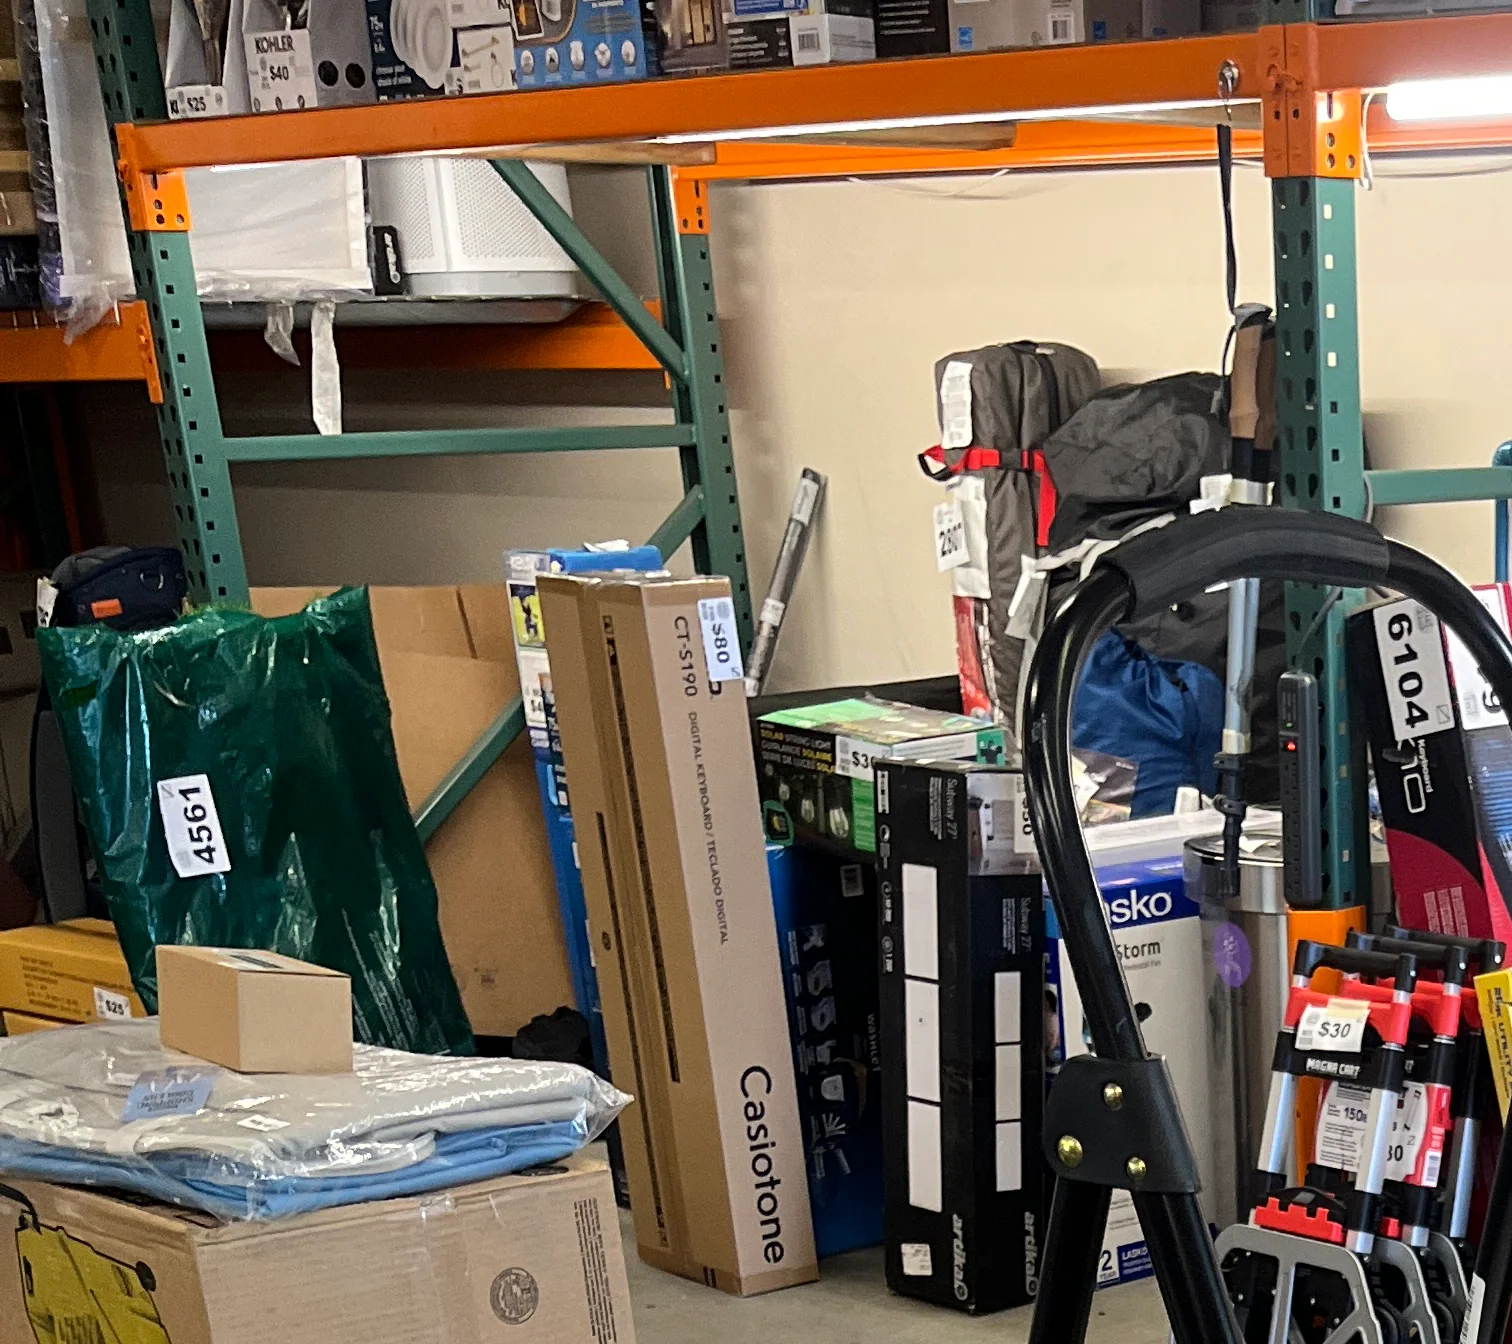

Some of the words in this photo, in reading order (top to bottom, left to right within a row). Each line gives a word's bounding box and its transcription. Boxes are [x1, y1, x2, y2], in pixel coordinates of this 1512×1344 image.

[254, 36, 295, 54] KOHLER
[269, 66, 290, 82] $40
[674, 615, 699, 698] CT-S190
[712, 621, 731, 664] $80
[1388, 612, 1429, 729] 6104
[179, 784, 218, 867] 4561
[688, 711, 703, 761] DIGITAL
[696, 763, 713, 831] KEYBOARD
[706, 839, 722, 896] TECLADO
[715, 898, 729, 946] DIGITAL
[1318, 1022, 1352, 1039] $30
[739, 1064, 785, 1265] Casiotone
